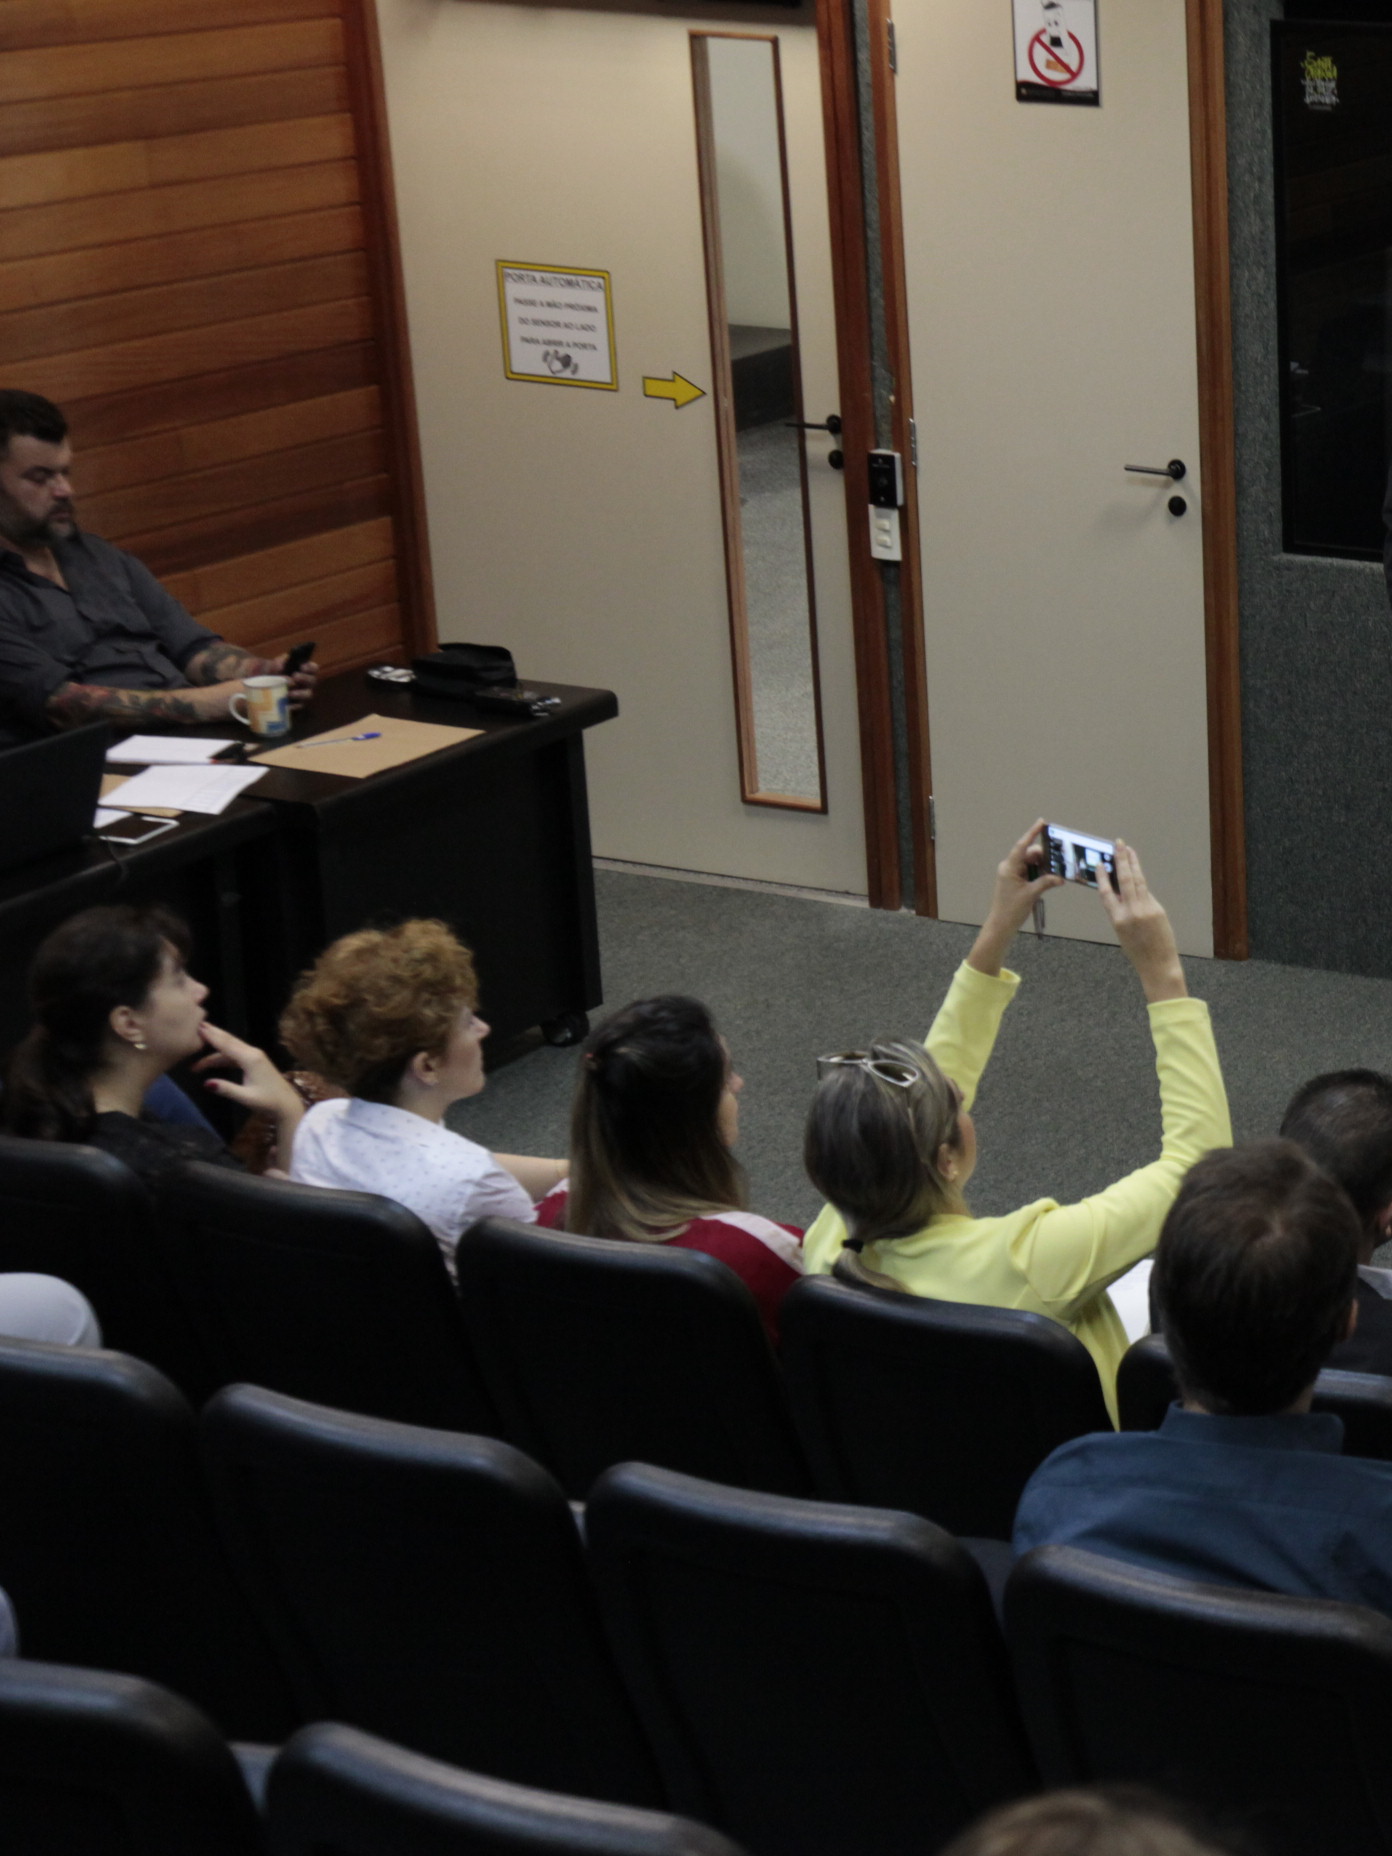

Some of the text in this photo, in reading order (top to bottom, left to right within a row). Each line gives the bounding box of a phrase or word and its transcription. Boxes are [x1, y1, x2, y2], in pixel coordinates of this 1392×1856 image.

[504, 271, 537, 284] PORTA
[518, 317, 530, 326] DO
[531, 318, 562, 328] SENSOR
[520, 336, 540, 345] PARA
[572, 341, 598, 351] PORTA
